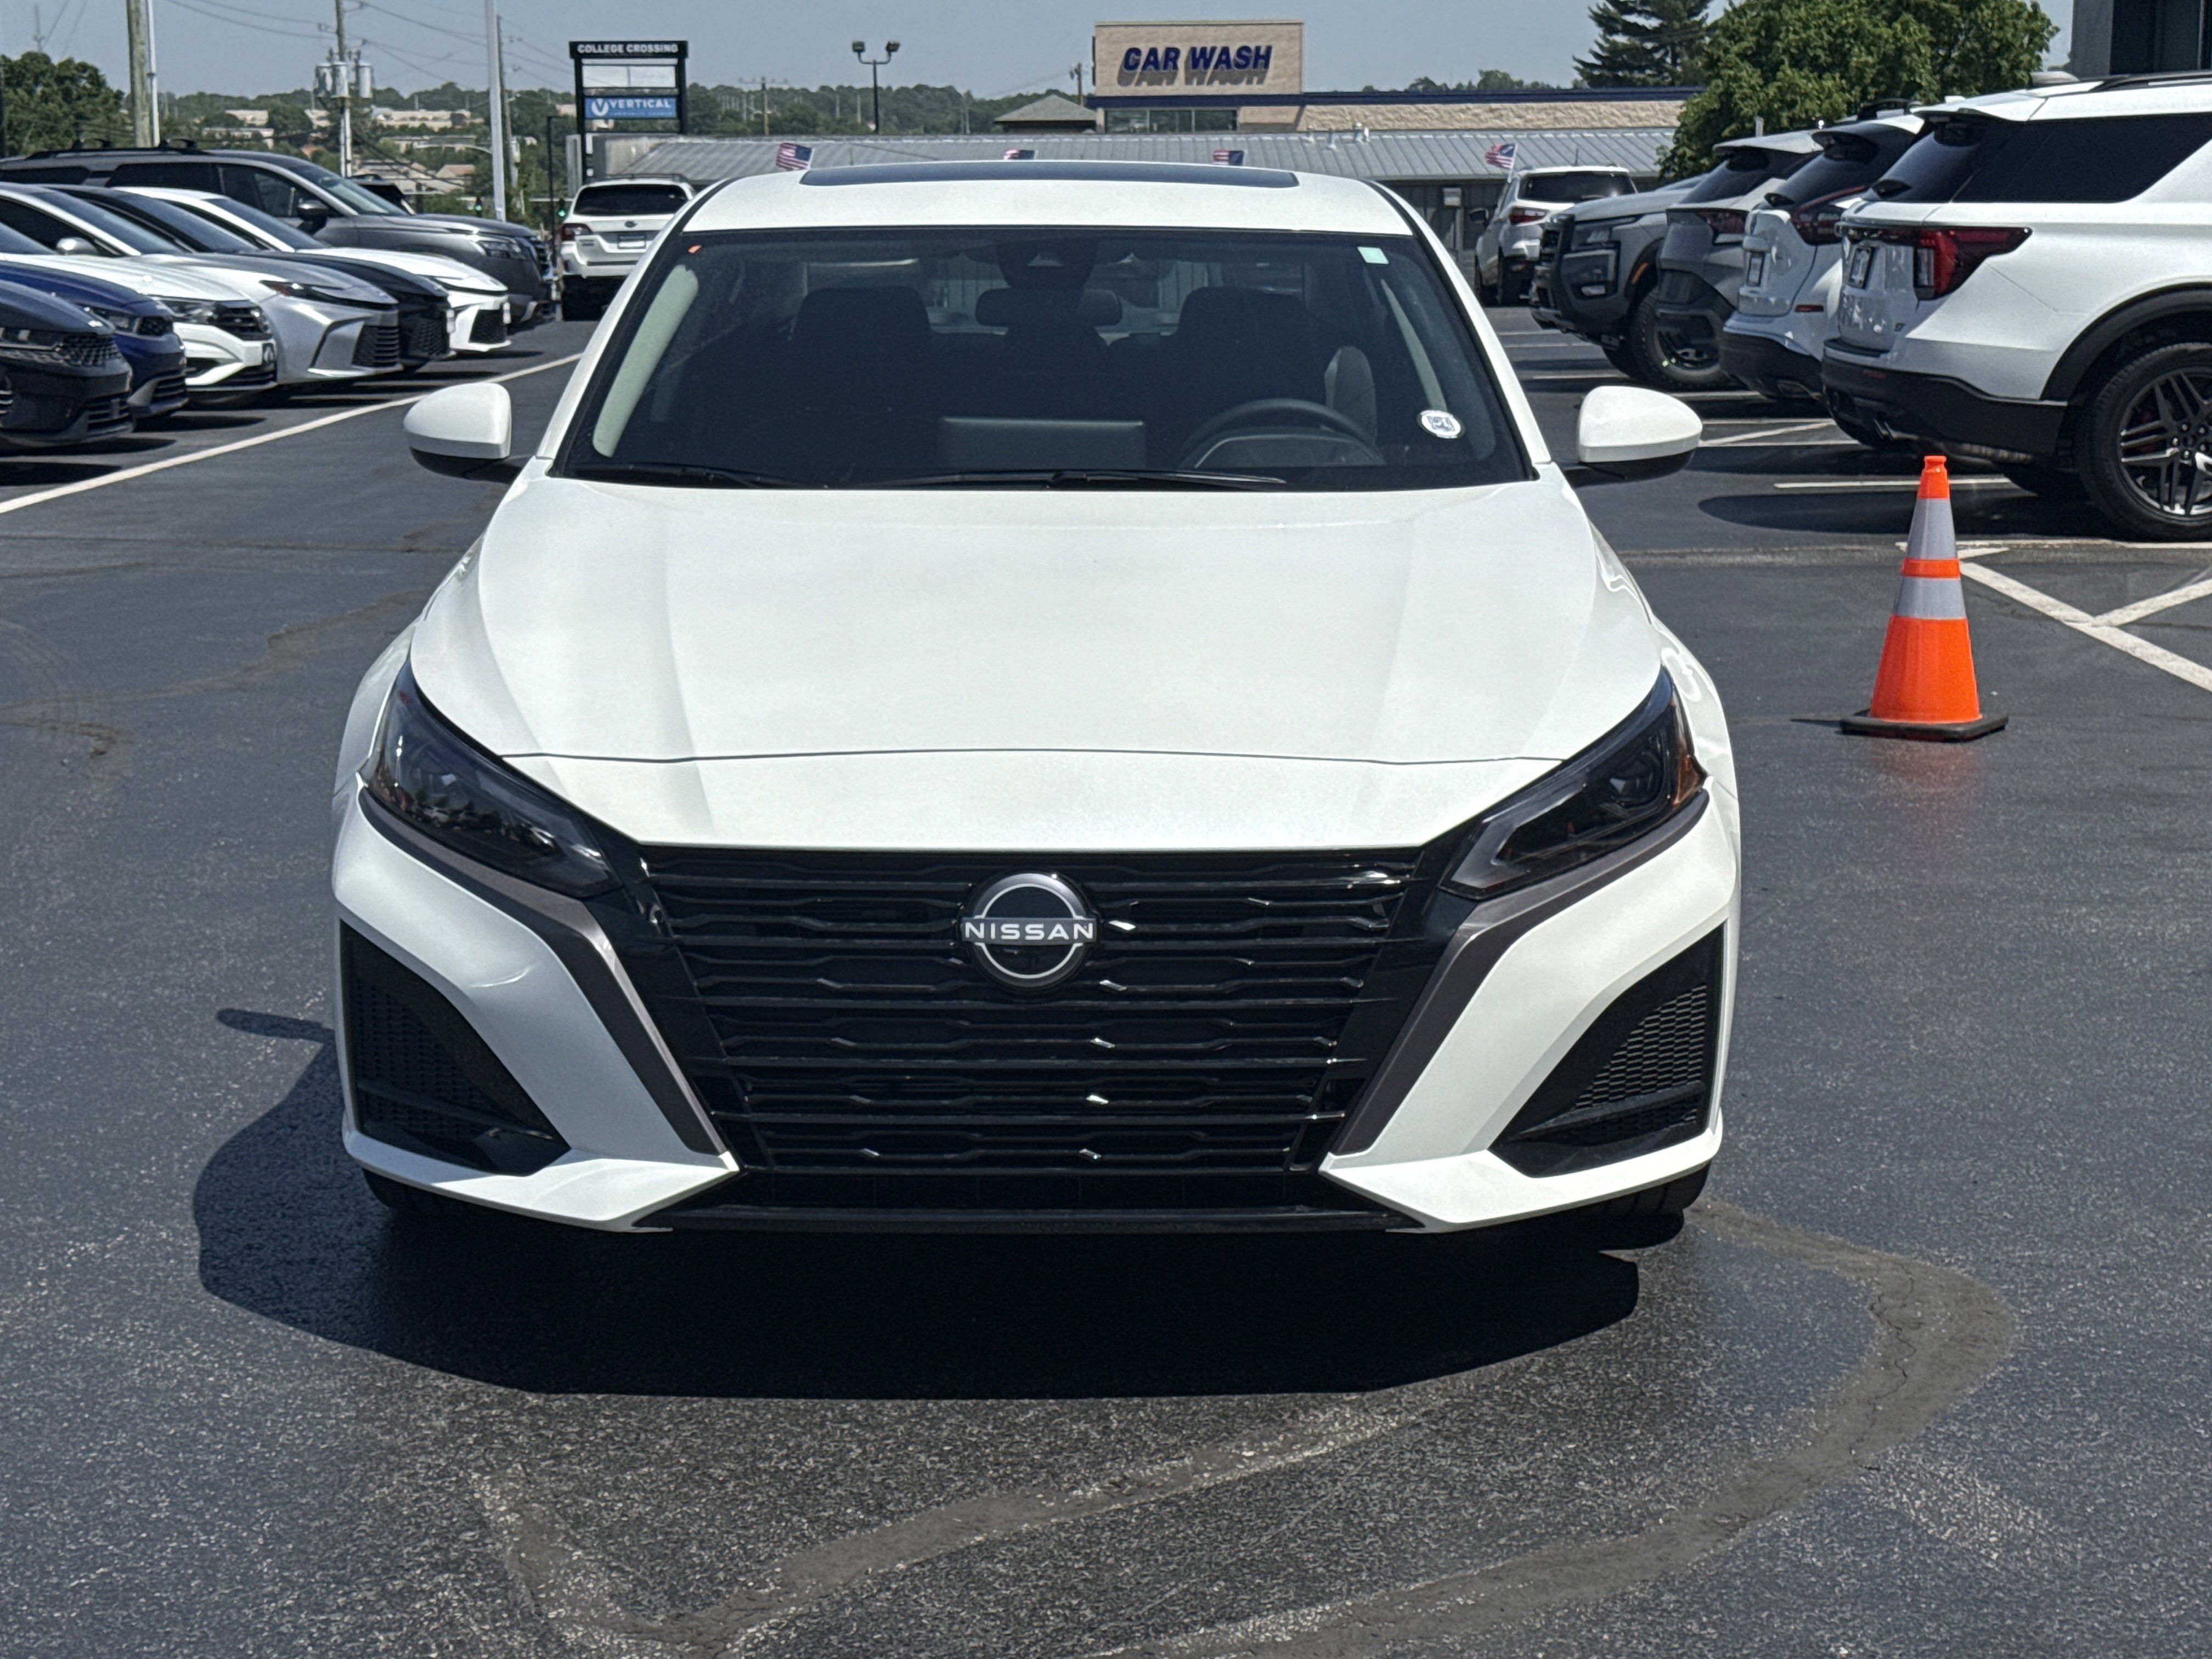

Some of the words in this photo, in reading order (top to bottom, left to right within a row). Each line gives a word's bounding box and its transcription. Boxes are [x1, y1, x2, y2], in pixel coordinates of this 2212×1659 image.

[577, 43, 624, 53] COLLEGE
[626, 43, 678, 53] CROSSING
[1124, 47, 1180, 71] CAR
[1189, 45, 1272, 70] WASH
[609, 99, 671, 108] VERTICAL
[965, 922, 1093, 940] NISSAN
